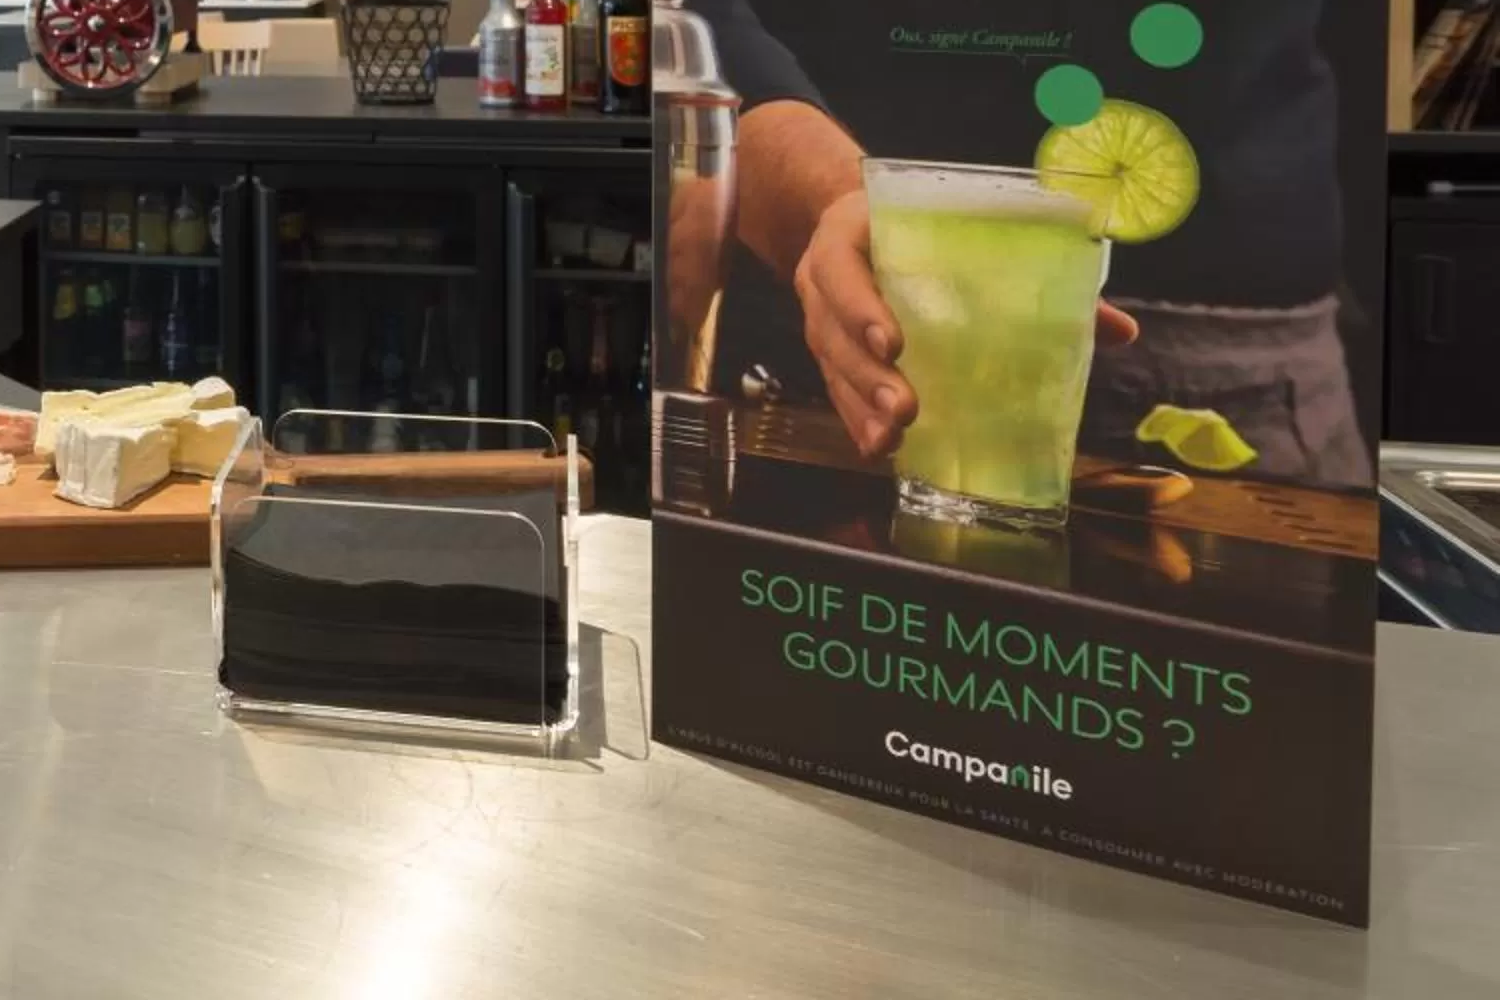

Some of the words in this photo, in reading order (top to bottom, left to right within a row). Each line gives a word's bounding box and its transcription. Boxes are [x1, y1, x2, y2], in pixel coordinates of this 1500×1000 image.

[741, 569, 844, 621] SOIF
[861, 593, 928, 643] DE
[946, 611, 1253, 715] MOMENTS
[783, 632, 1144, 750] GOURMANDS
[1162, 718, 1196, 760] ?
[884, 730, 1073, 800] Campanile
